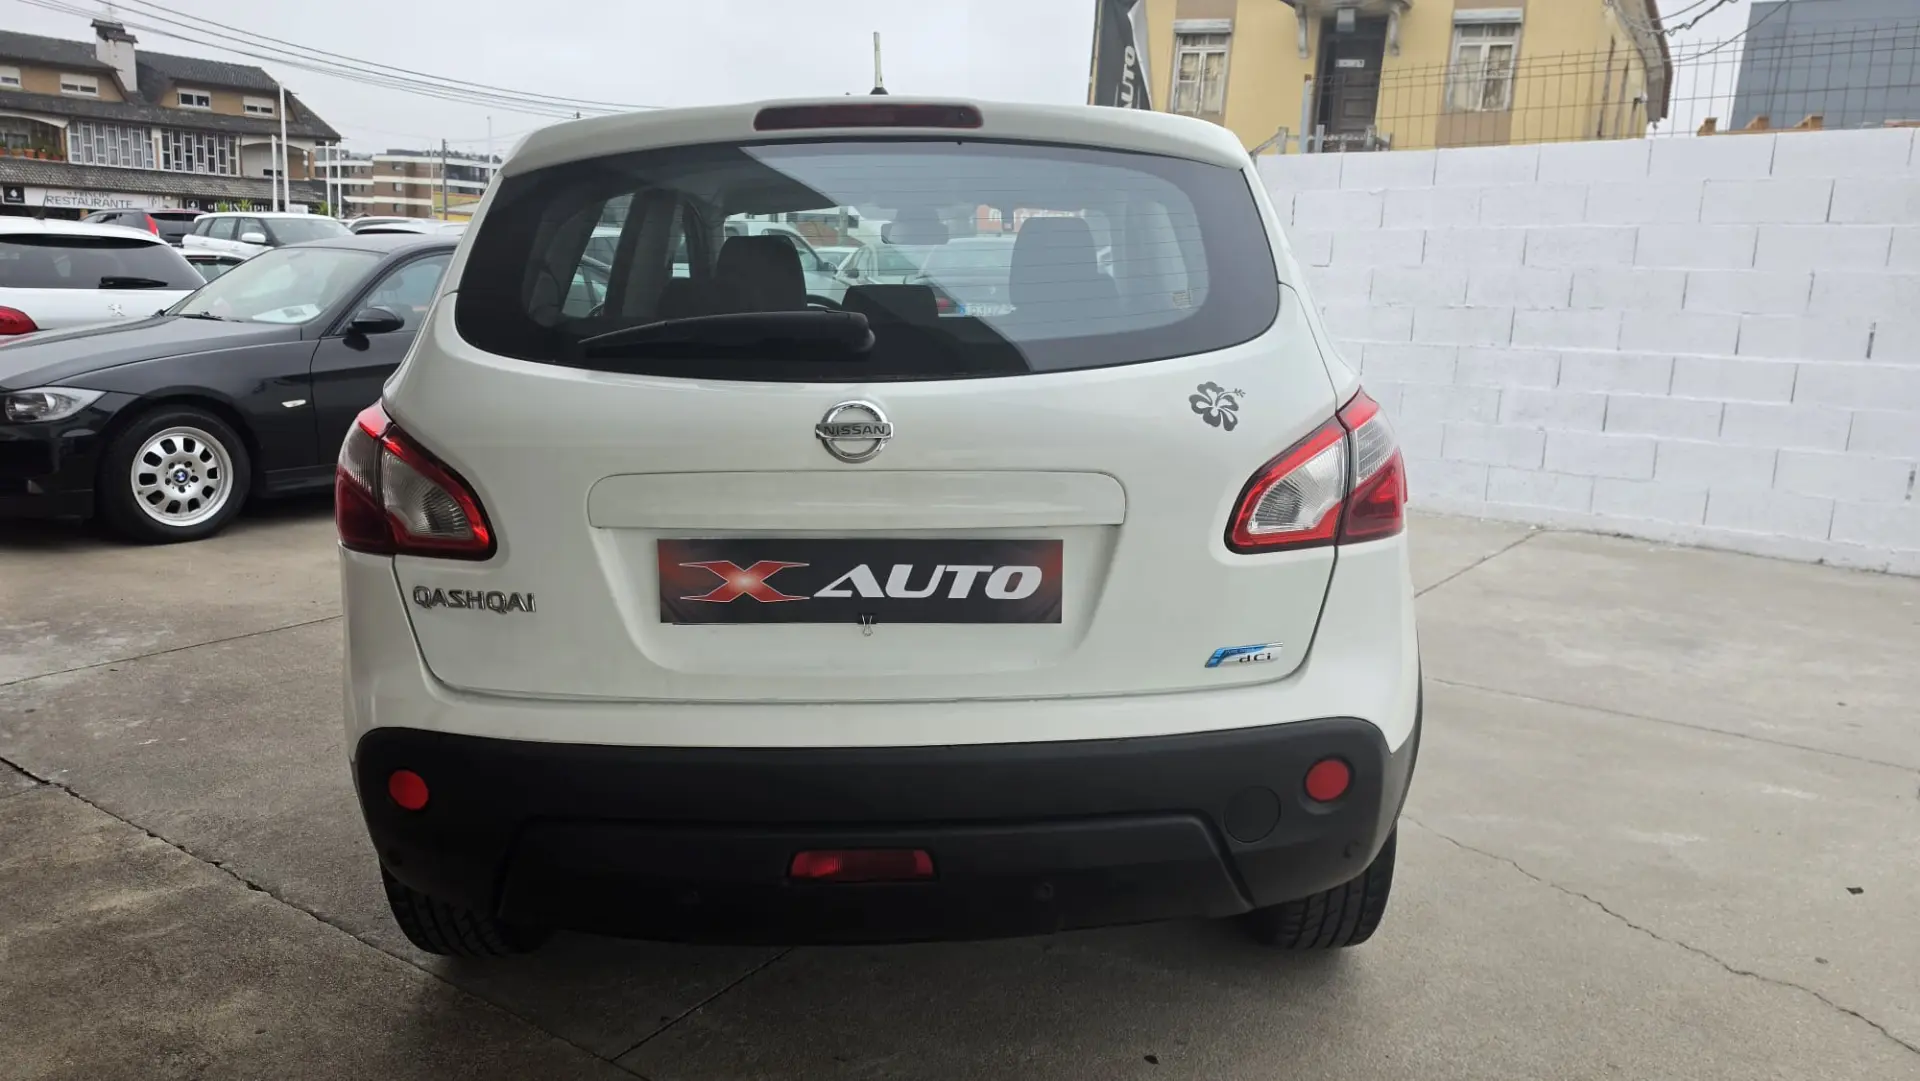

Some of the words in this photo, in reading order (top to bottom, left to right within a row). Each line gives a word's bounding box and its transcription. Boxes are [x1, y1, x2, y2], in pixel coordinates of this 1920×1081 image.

[1120, 45, 1136, 109] UTO
[46, 195, 133, 209] RESTAURANTE
[823, 425, 885, 436] NISSAN
[678, 559, 811, 603] X
[813, 563, 1043, 600] AUTO
[412, 585, 537, 614] QASHQAI
